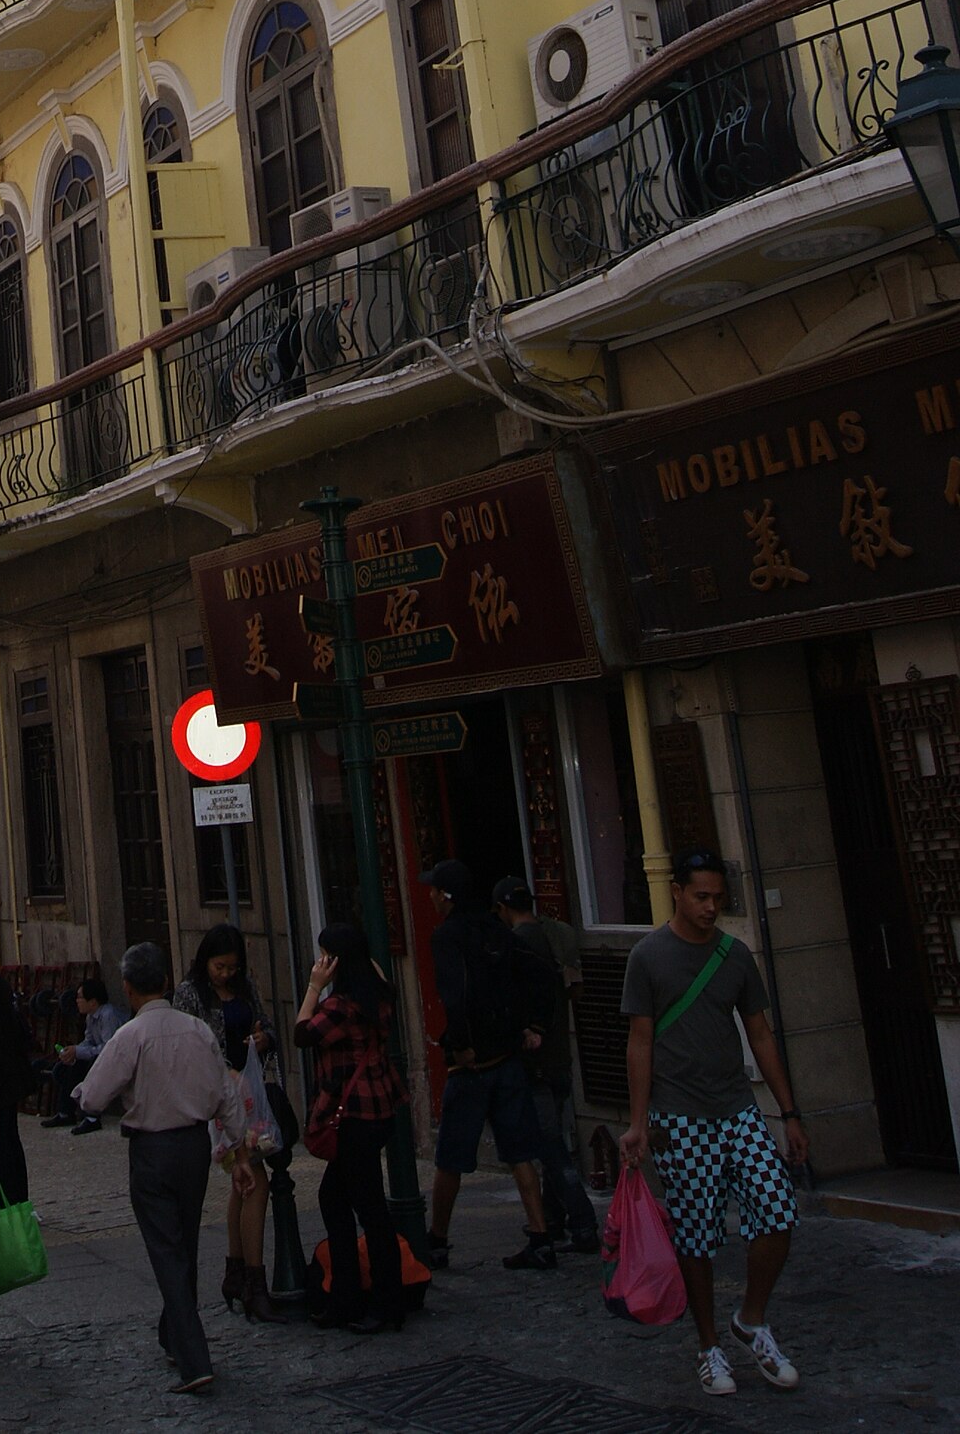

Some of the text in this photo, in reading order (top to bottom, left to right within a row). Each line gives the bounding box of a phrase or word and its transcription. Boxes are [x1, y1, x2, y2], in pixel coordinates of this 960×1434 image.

[656, 410, 866, 503] MOBILIAS
[222, 499, 512, 601] MOBILIAS MEI CHOI
